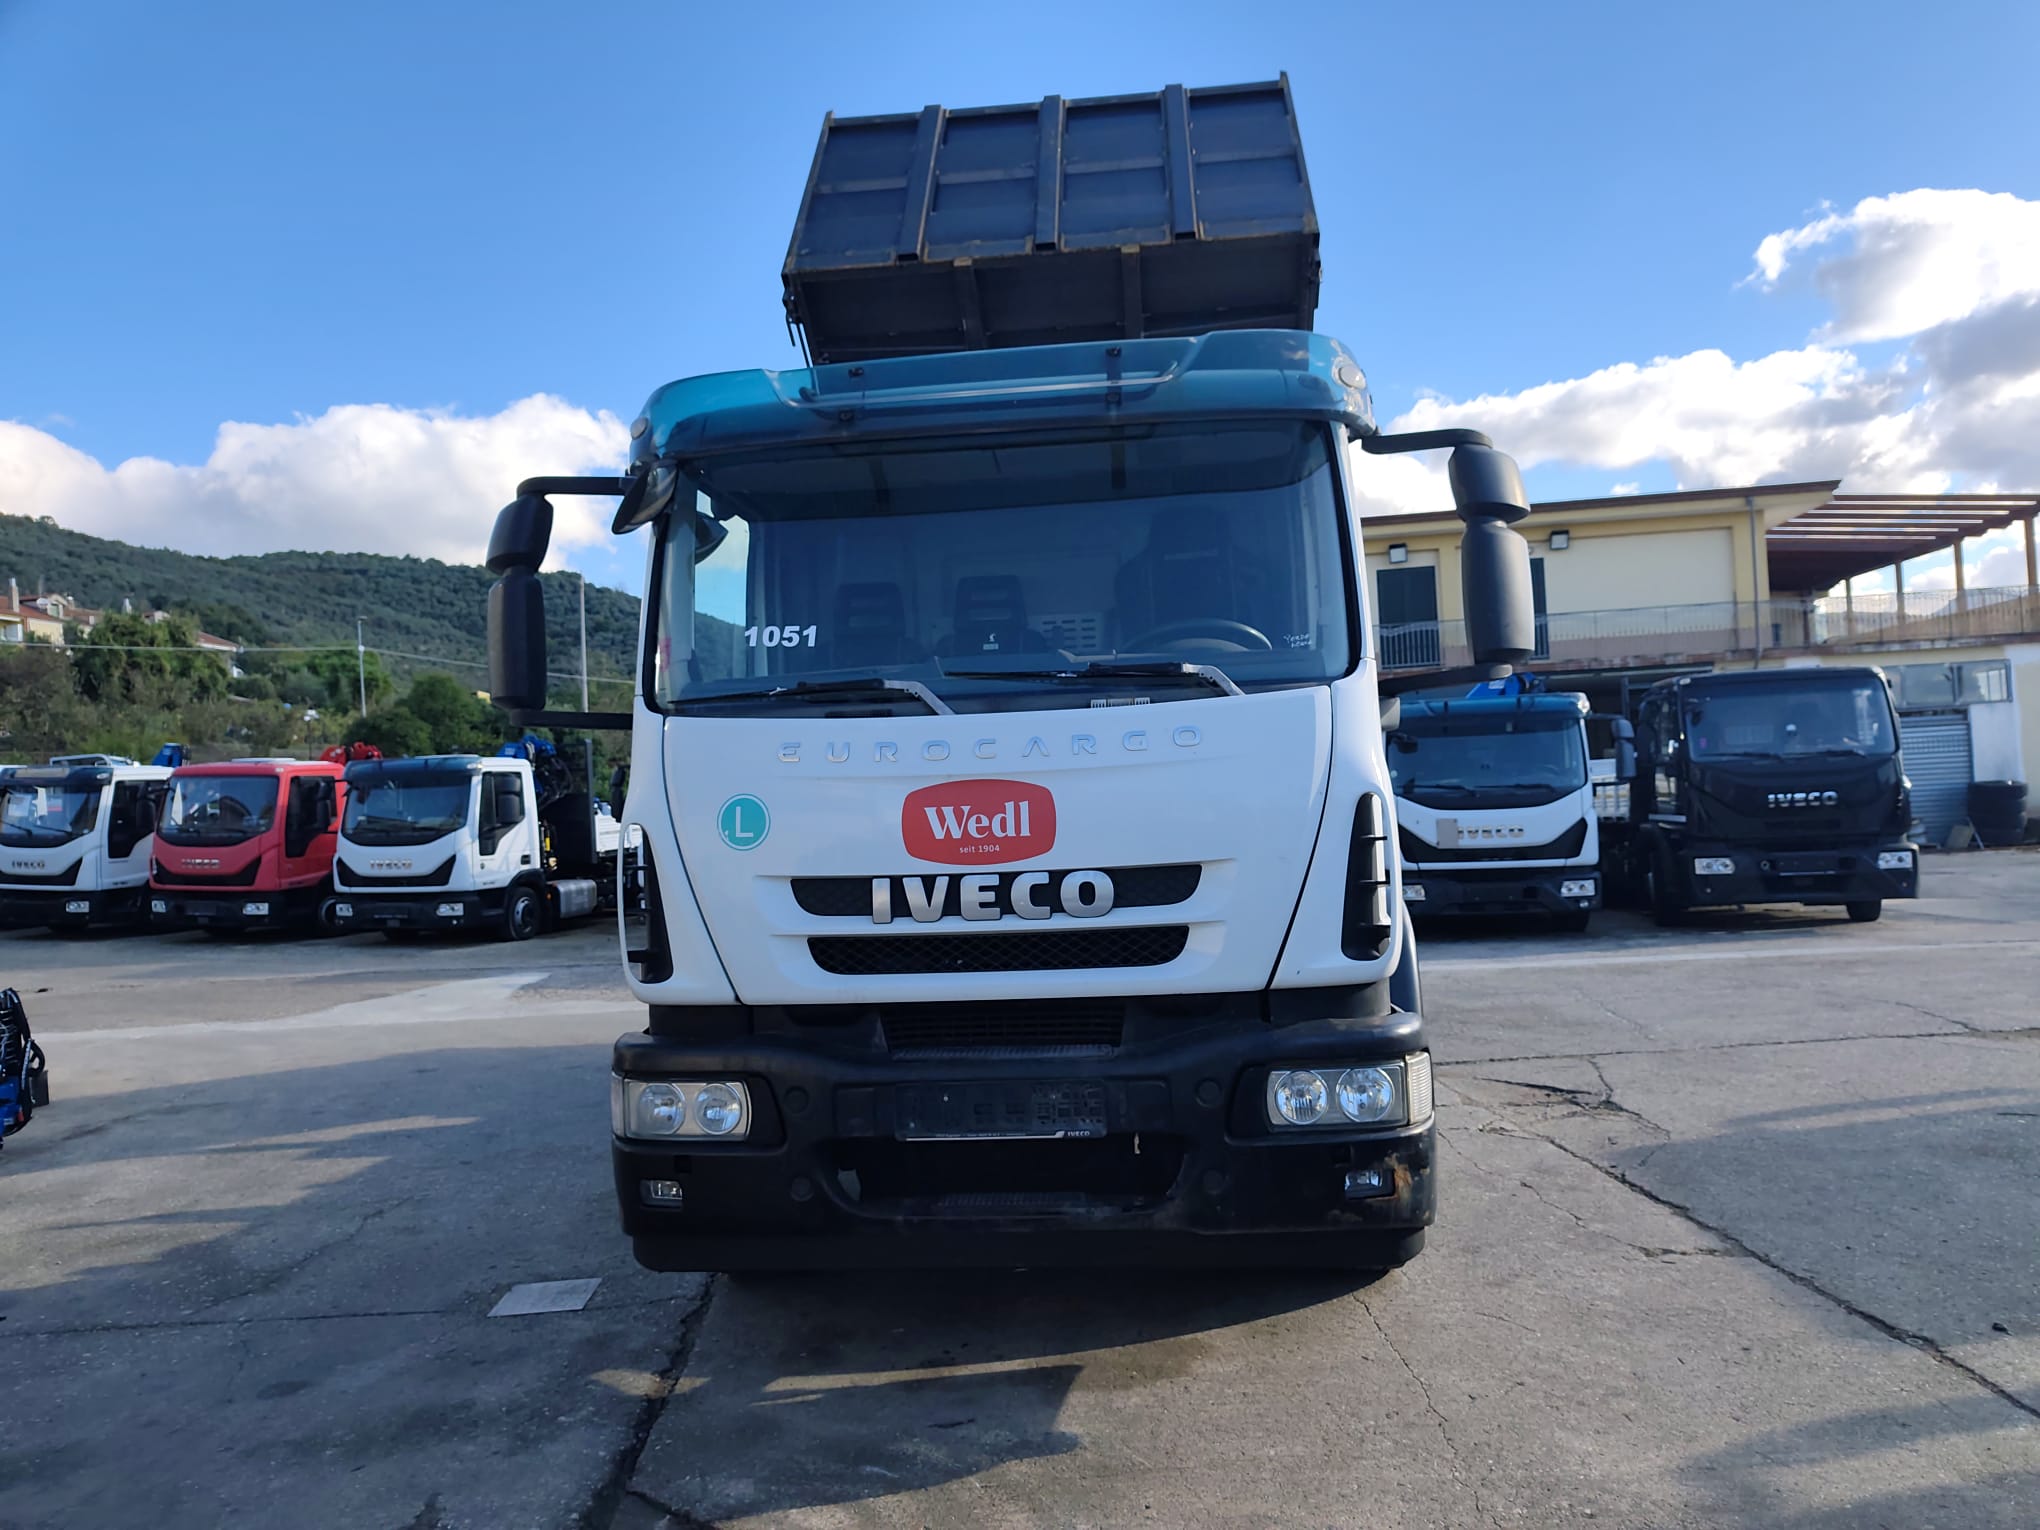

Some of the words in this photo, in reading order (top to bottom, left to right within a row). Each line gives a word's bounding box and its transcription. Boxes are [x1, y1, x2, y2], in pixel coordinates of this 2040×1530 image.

[744, 625, 817, 647] 1051
[777, 726, 1201, 763] EUROCARGO
[1767, 791, 1838, 808] IVECO
[735, 806, 754, 838] L
[924, 800, 1031, 840] Wedl
[959, 845, 976, 854] seit
[978, 844, 1000, 853] 1904
[871, 870, 1115, 924] IVECO
